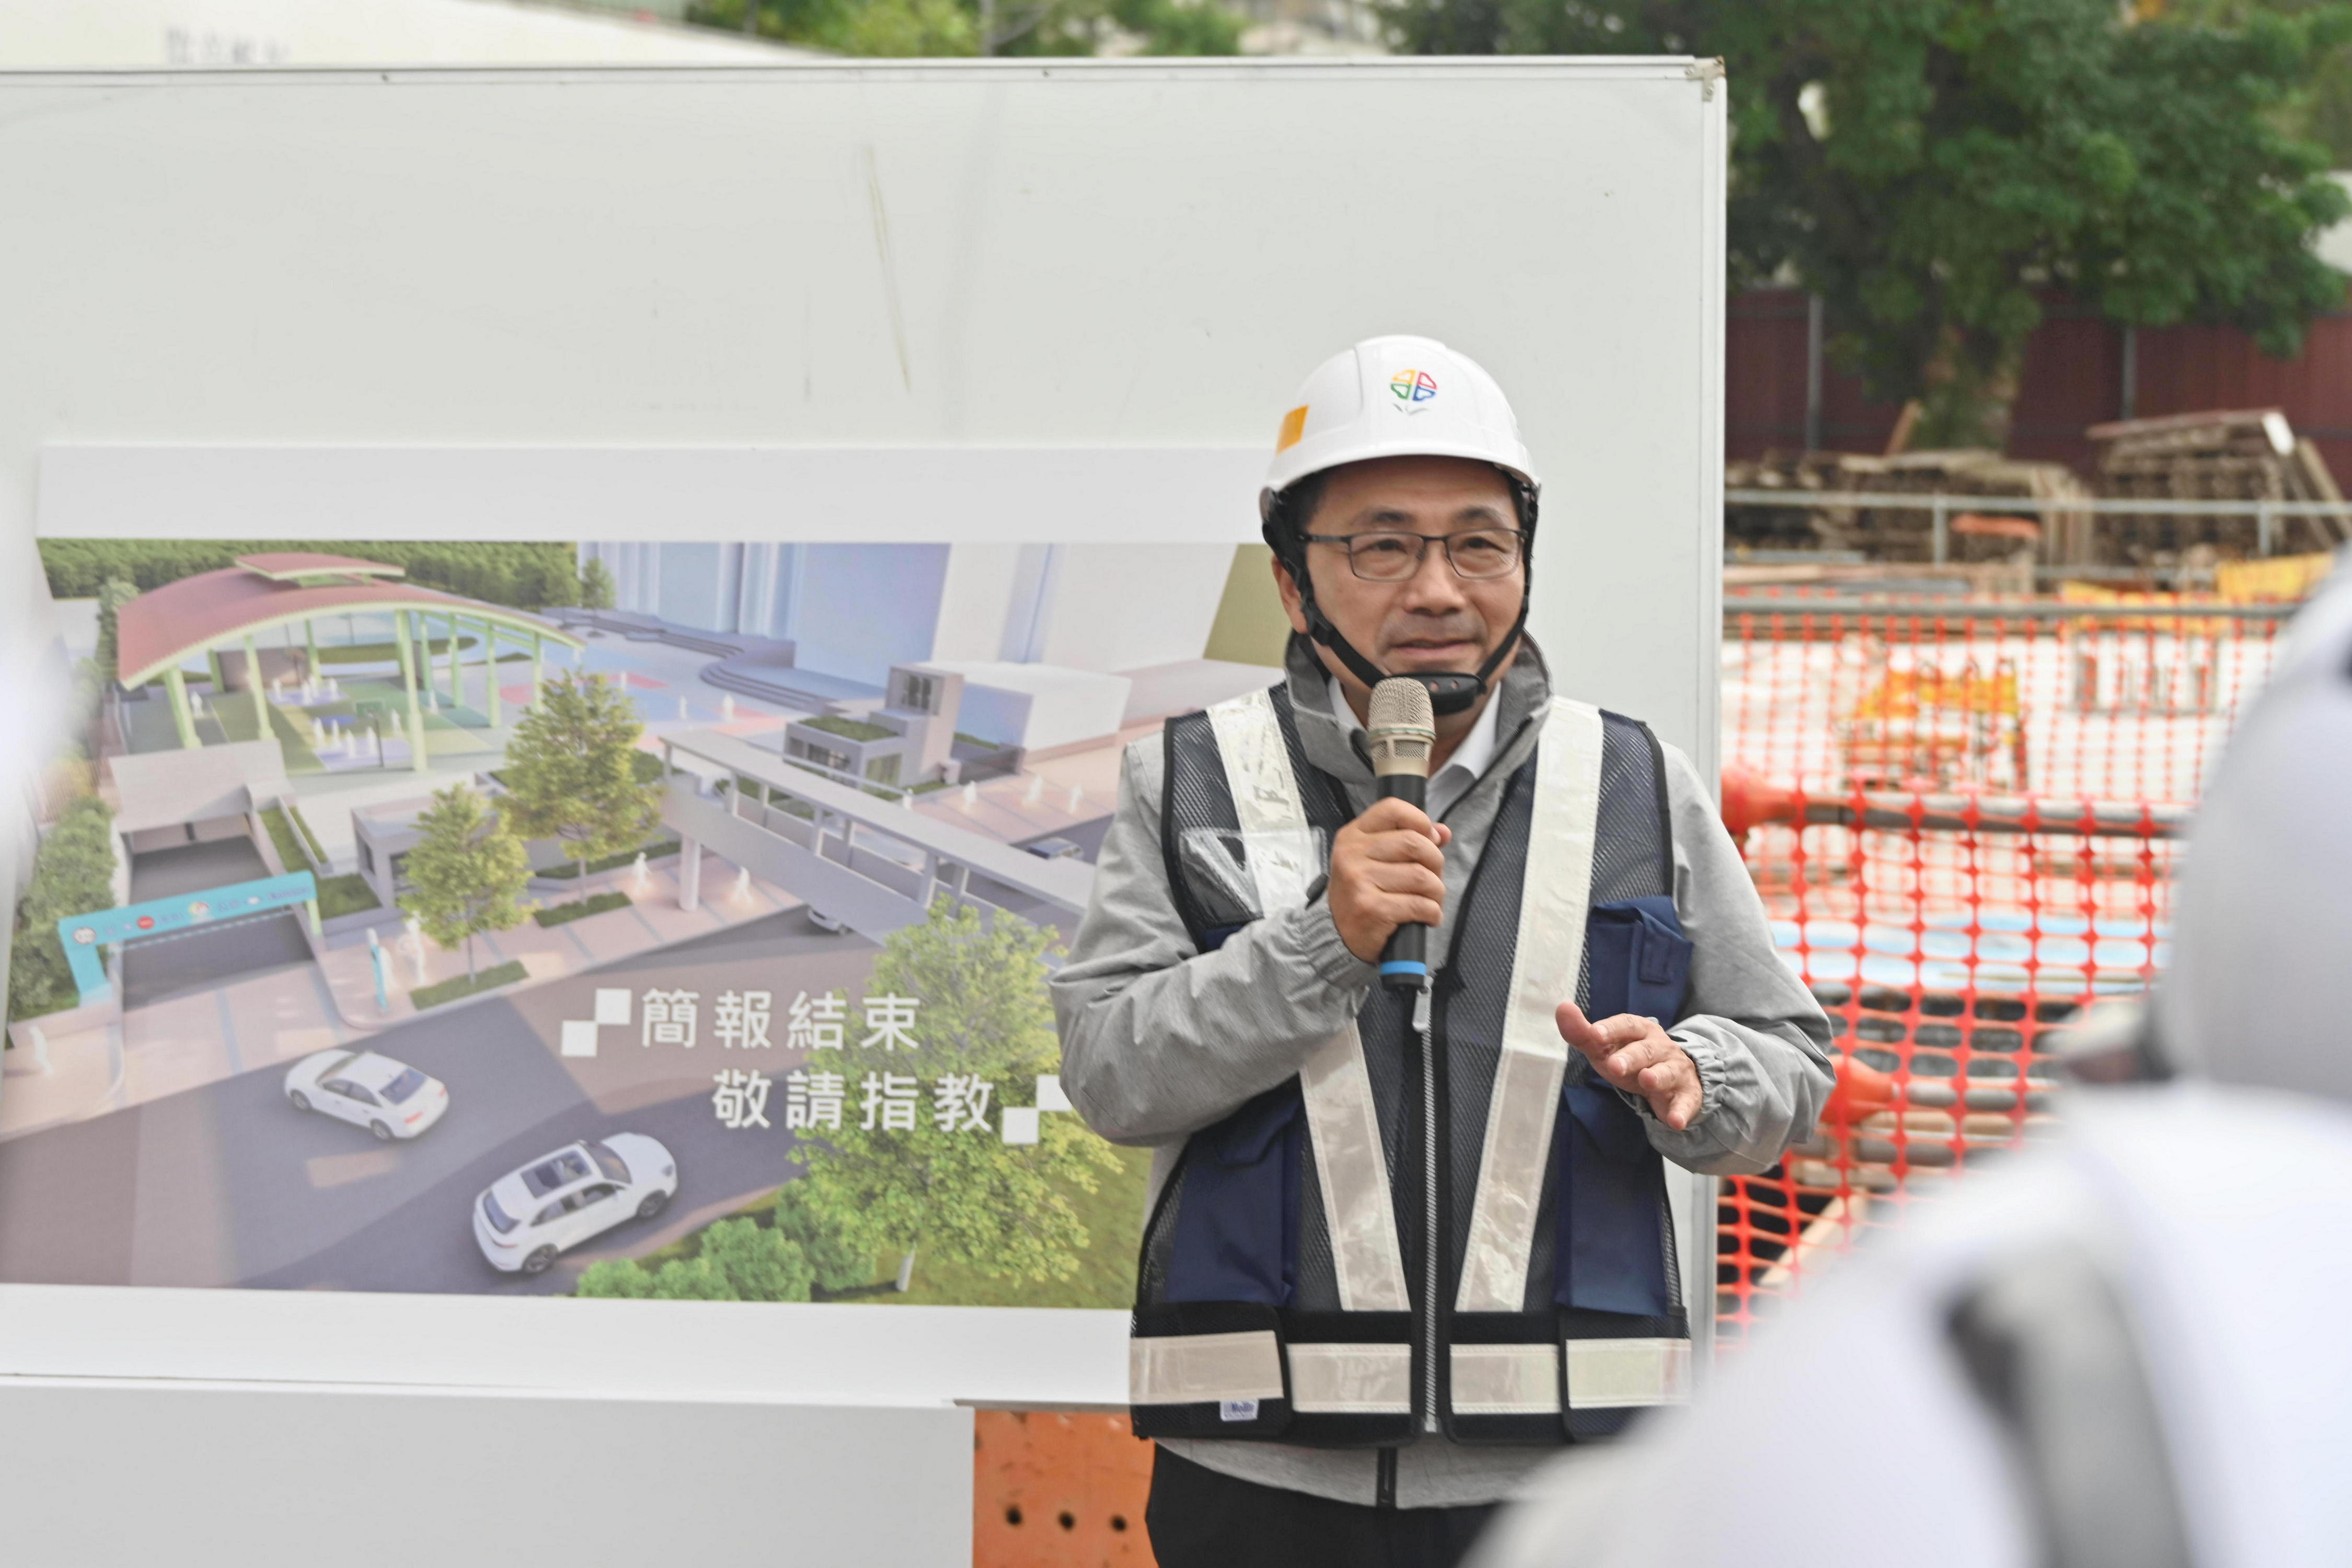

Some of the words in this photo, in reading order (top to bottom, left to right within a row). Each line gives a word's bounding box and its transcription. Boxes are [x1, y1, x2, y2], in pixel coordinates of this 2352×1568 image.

[641, 988, 920, 1051] 簡報結束
[712, 1068, 993, 1133] 敬請指教
